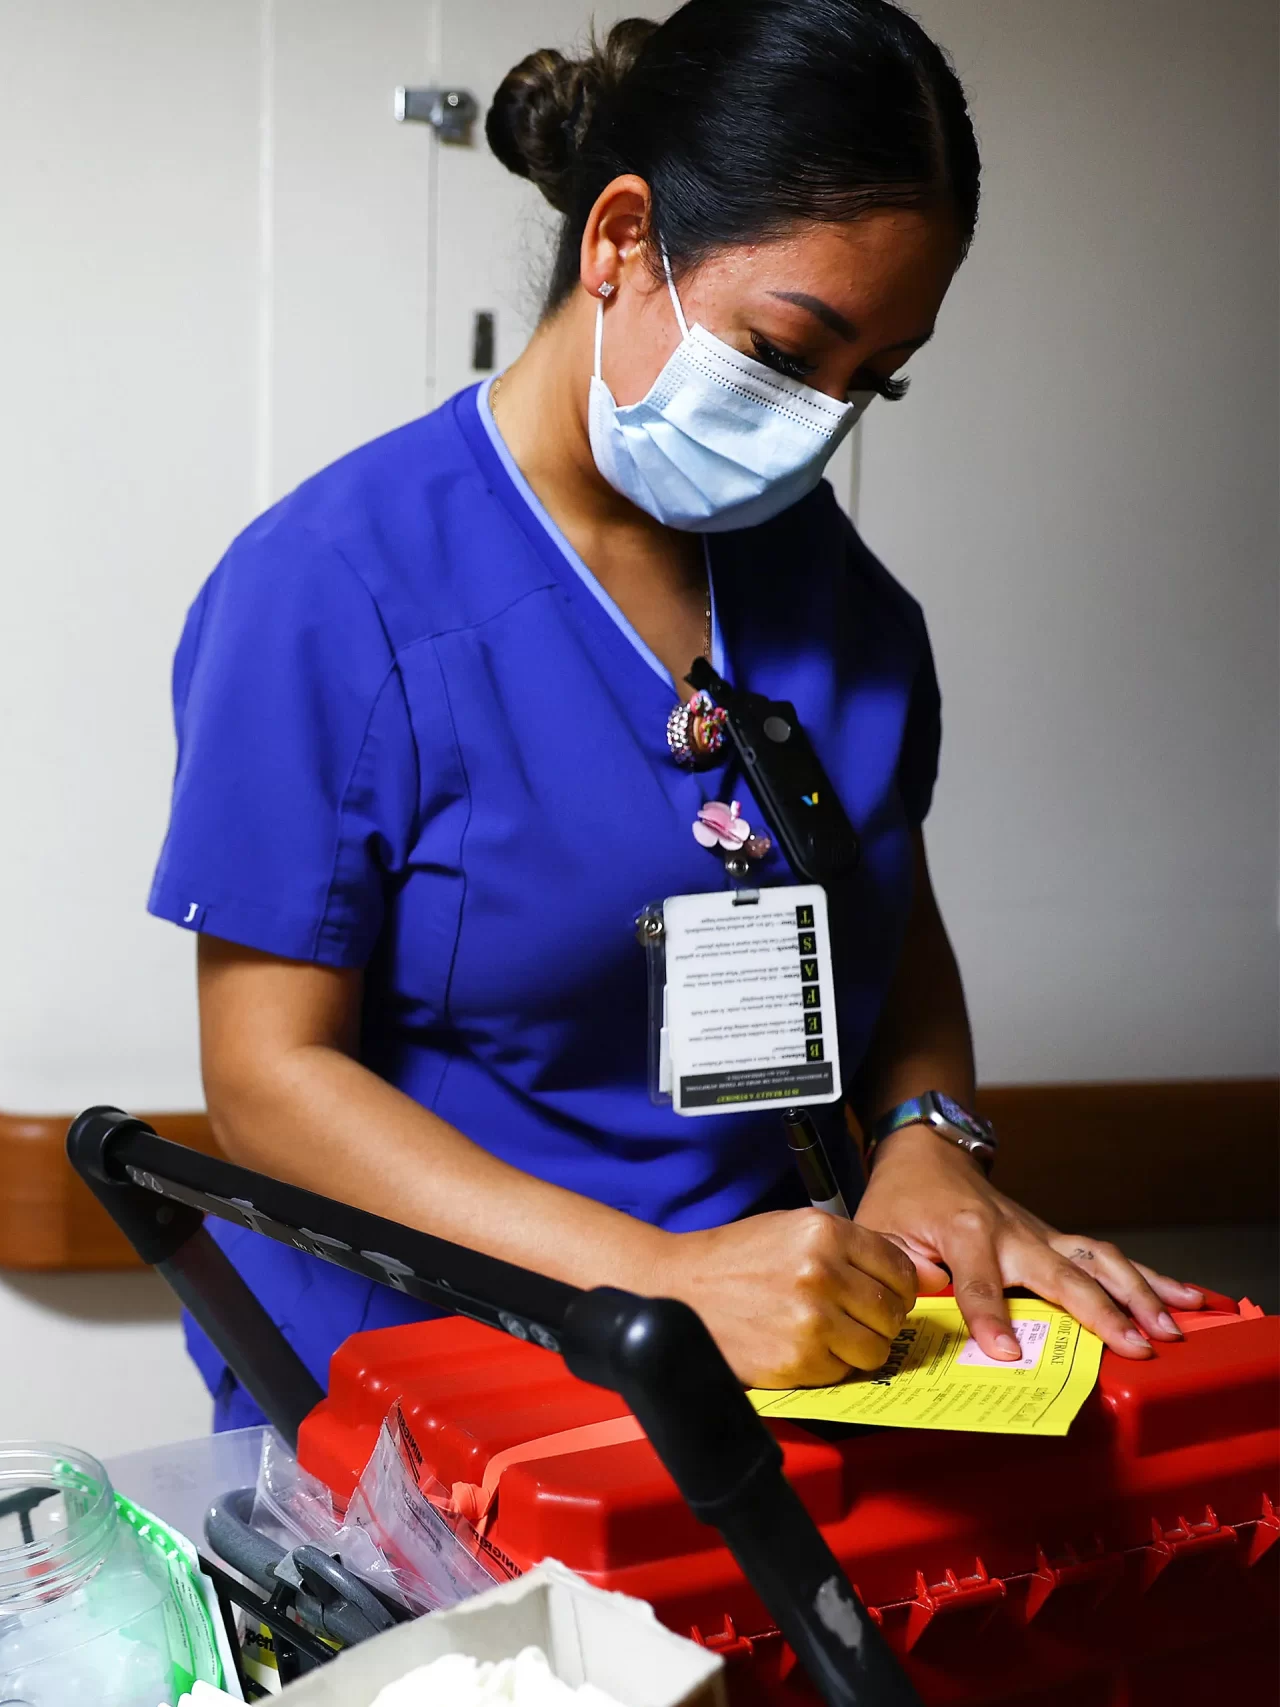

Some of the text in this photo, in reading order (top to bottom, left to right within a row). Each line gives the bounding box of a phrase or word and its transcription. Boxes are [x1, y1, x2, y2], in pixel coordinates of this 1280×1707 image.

[183, 902, 199, 923] J
[799, 909, 811, 925] T
[802, 935, 812, 950] S
[804, 962, 815, 977] A
[805, 988, 816, 1004] F
[807, 1016, 817, 1031] E
[809, 1042, 819, 1057] B
[1050, 1315, 1073, 1366] CODE STROKE
